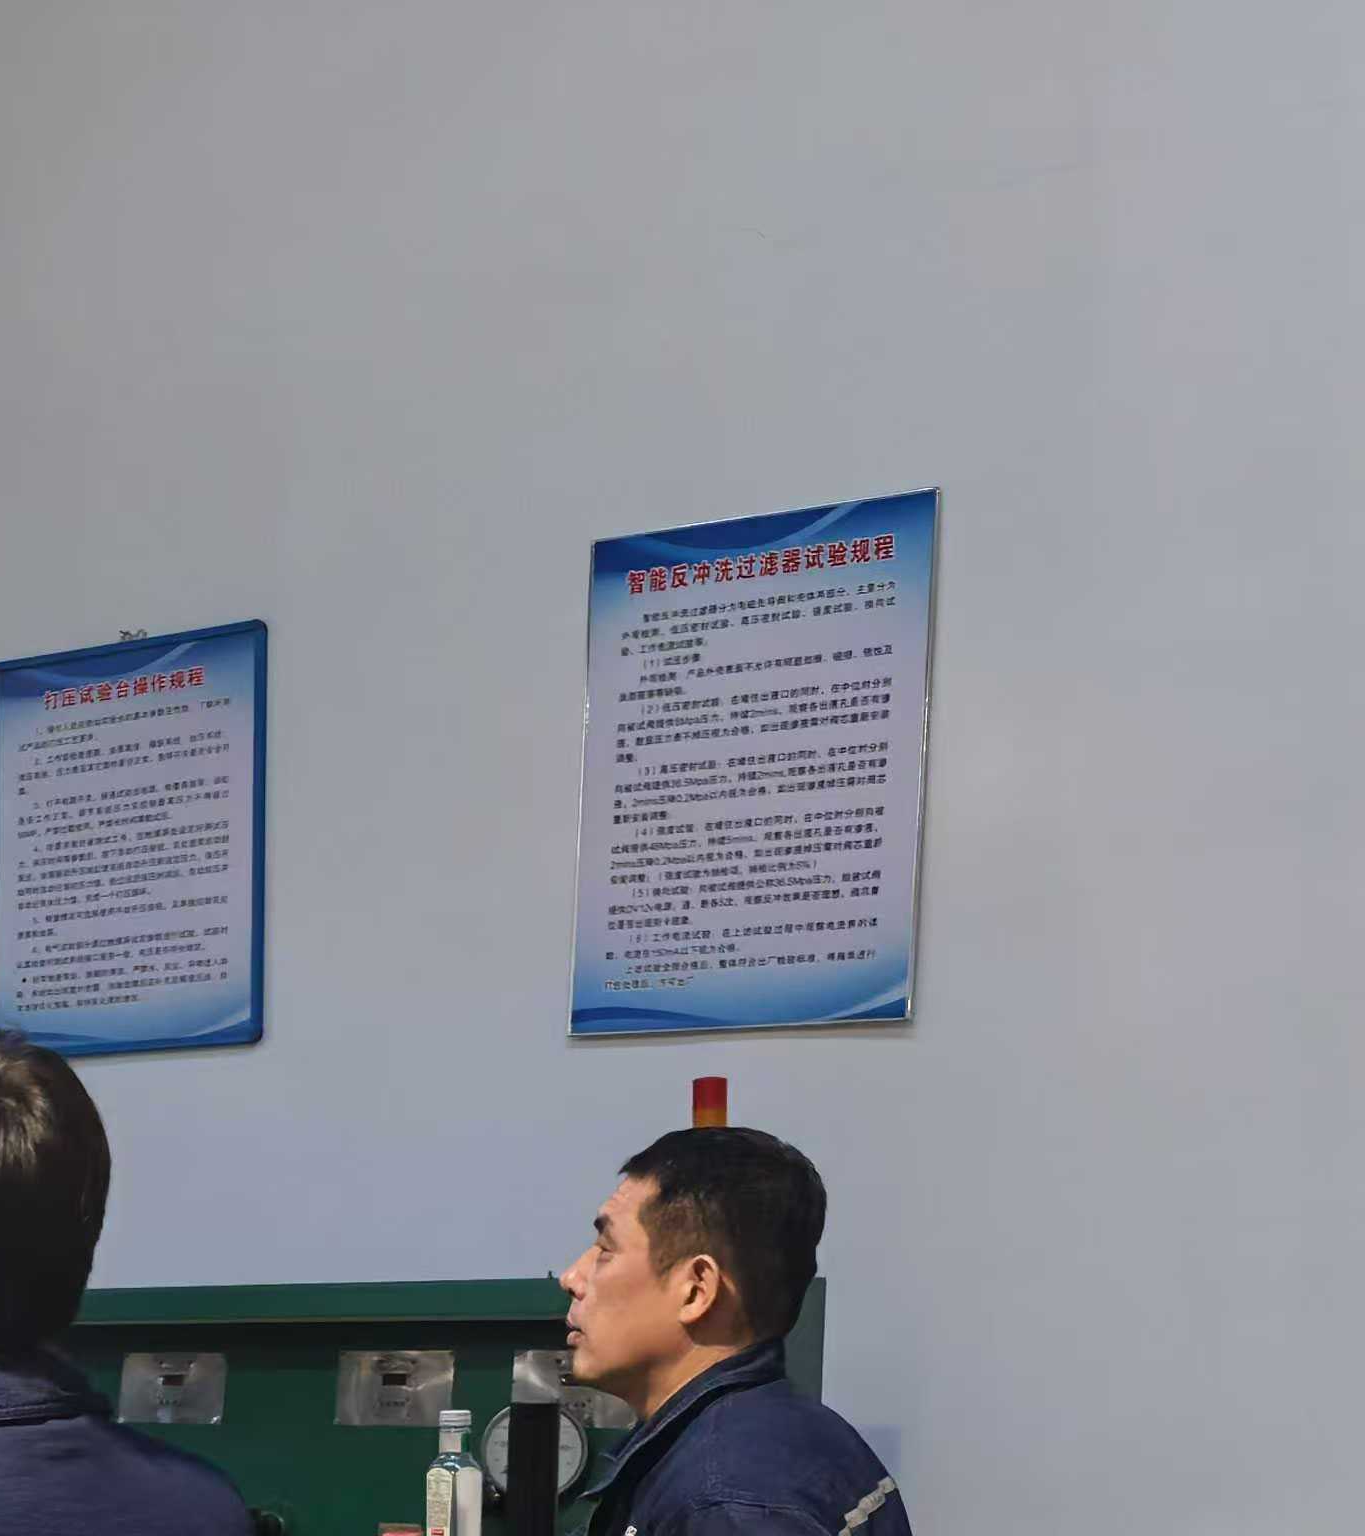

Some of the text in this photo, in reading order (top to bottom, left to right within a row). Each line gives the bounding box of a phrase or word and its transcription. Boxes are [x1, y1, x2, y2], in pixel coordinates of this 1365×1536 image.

[627, 533, 897, 595] 智能反冲洗过滤器试验规程
[43, 665, 206, 710] 打压试验台操作规程
